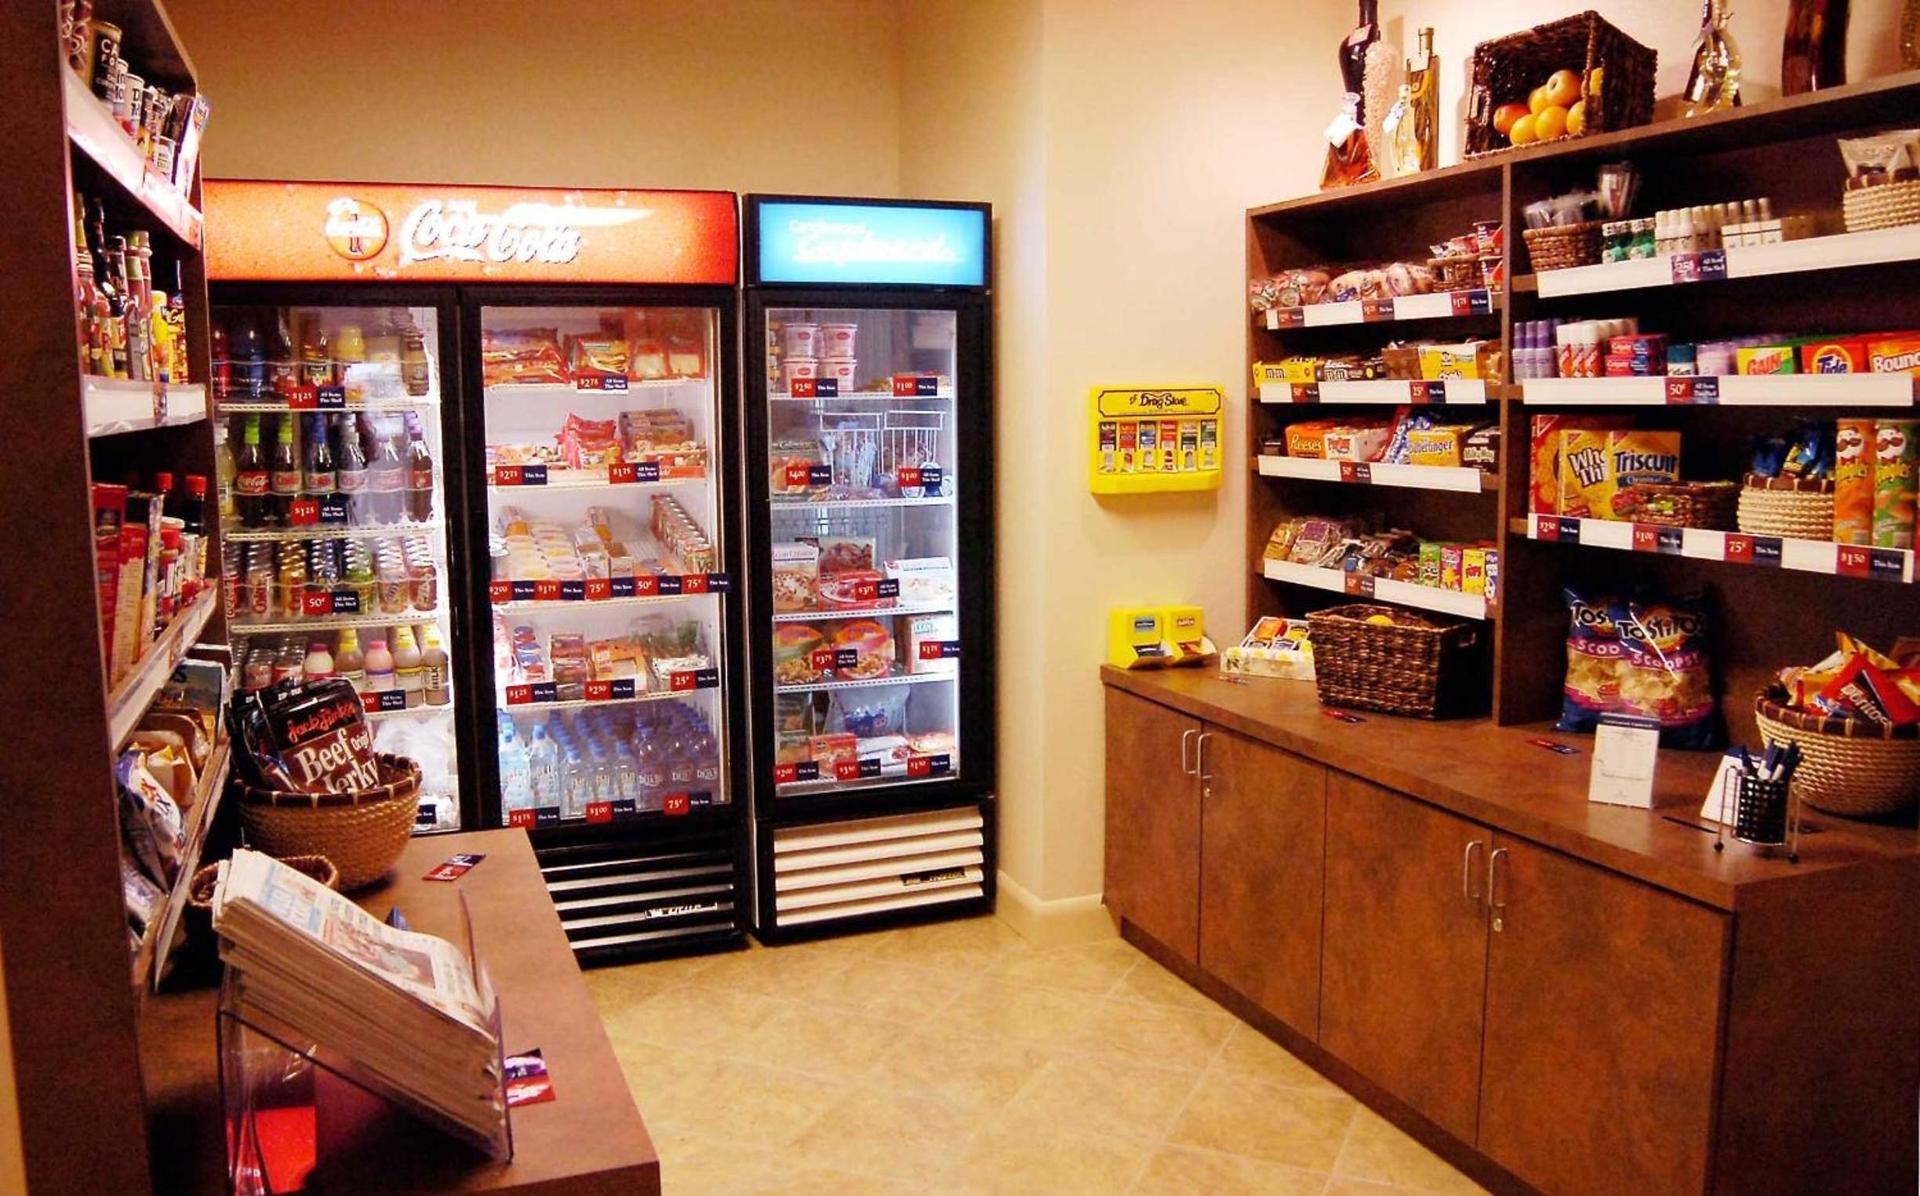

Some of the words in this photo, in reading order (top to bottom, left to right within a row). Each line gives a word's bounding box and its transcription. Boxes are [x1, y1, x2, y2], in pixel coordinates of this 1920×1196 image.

[400, 200, 585, 264] Coca-Cola
[1816, 353, 1849, 374] Tide
[1670, 383, 1686, 395] 50¢
[1614, 451, 1678, 473] Triscuit
[1728, 541, 1746, 553] 75¢
[1841, 683, 1888, 727] Doritos
[294, 727, 354, 787] Beef
[322, 757, 380, 794] Jerky
